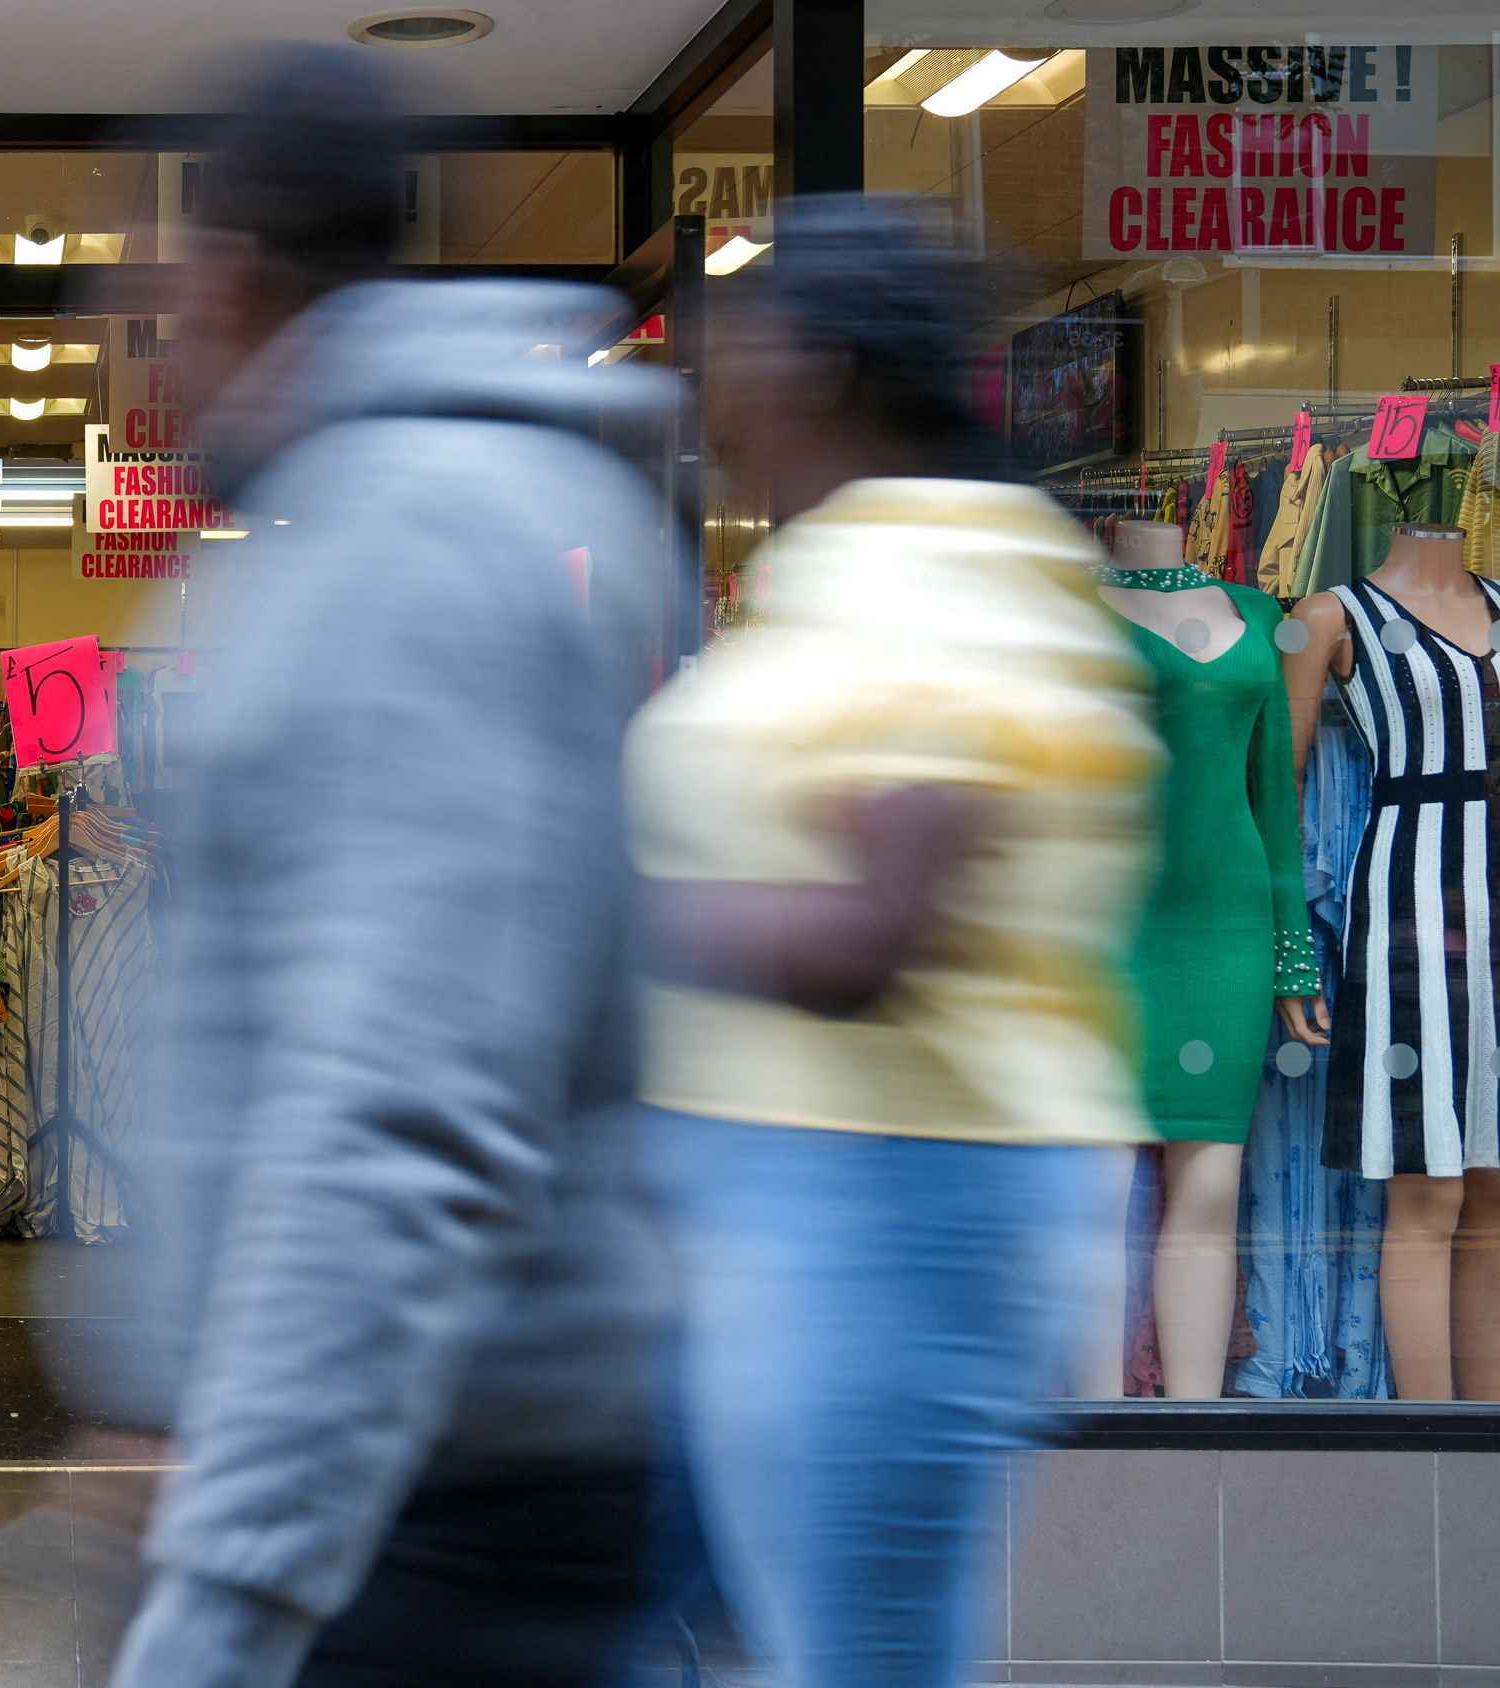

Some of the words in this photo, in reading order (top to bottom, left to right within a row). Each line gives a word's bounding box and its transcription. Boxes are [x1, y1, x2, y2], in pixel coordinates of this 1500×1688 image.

[1146, 112, 1369, 178] FASHION
[1108, 185, 1406, 252] CLEARANCE
[81, 554, 191, 579] CLEARANCE
